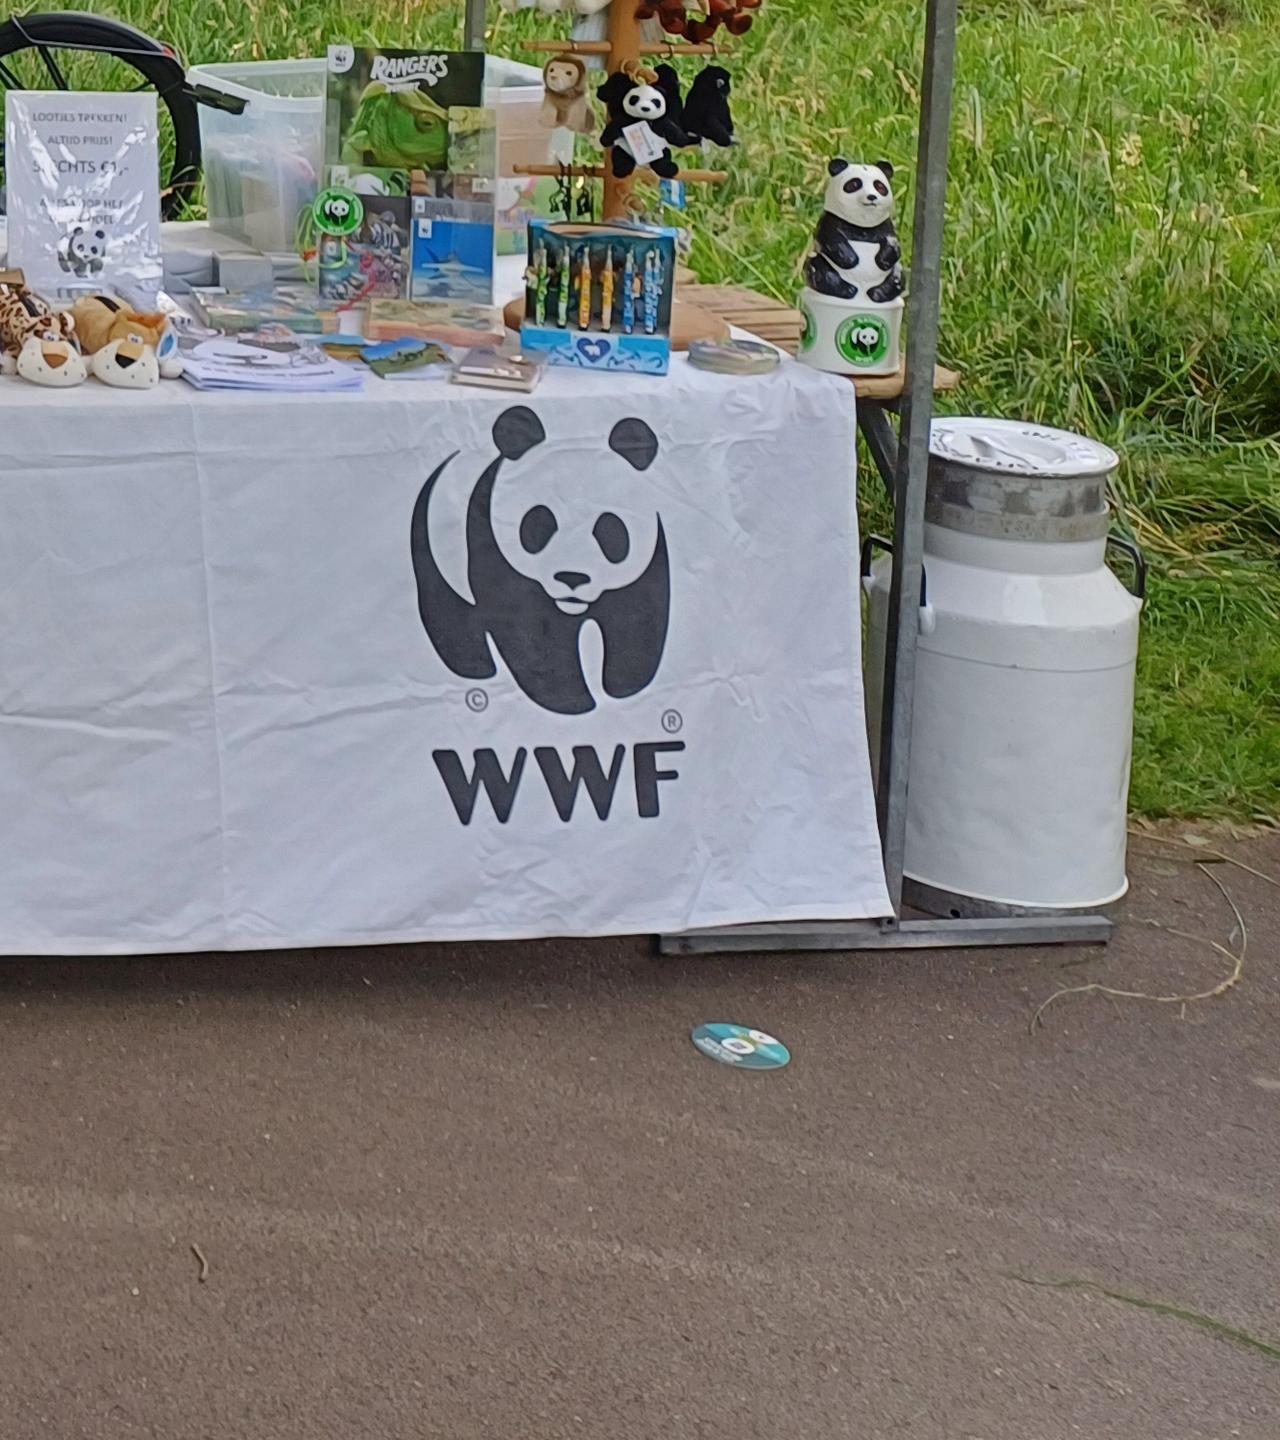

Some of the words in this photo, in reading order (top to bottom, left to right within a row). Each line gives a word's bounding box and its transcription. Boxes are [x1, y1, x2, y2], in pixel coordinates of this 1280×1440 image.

[370, 54, 449, 87] RANGERS
[33, 160, 96, 173] SCHTS
[432, 740, 686, 826] WWF
